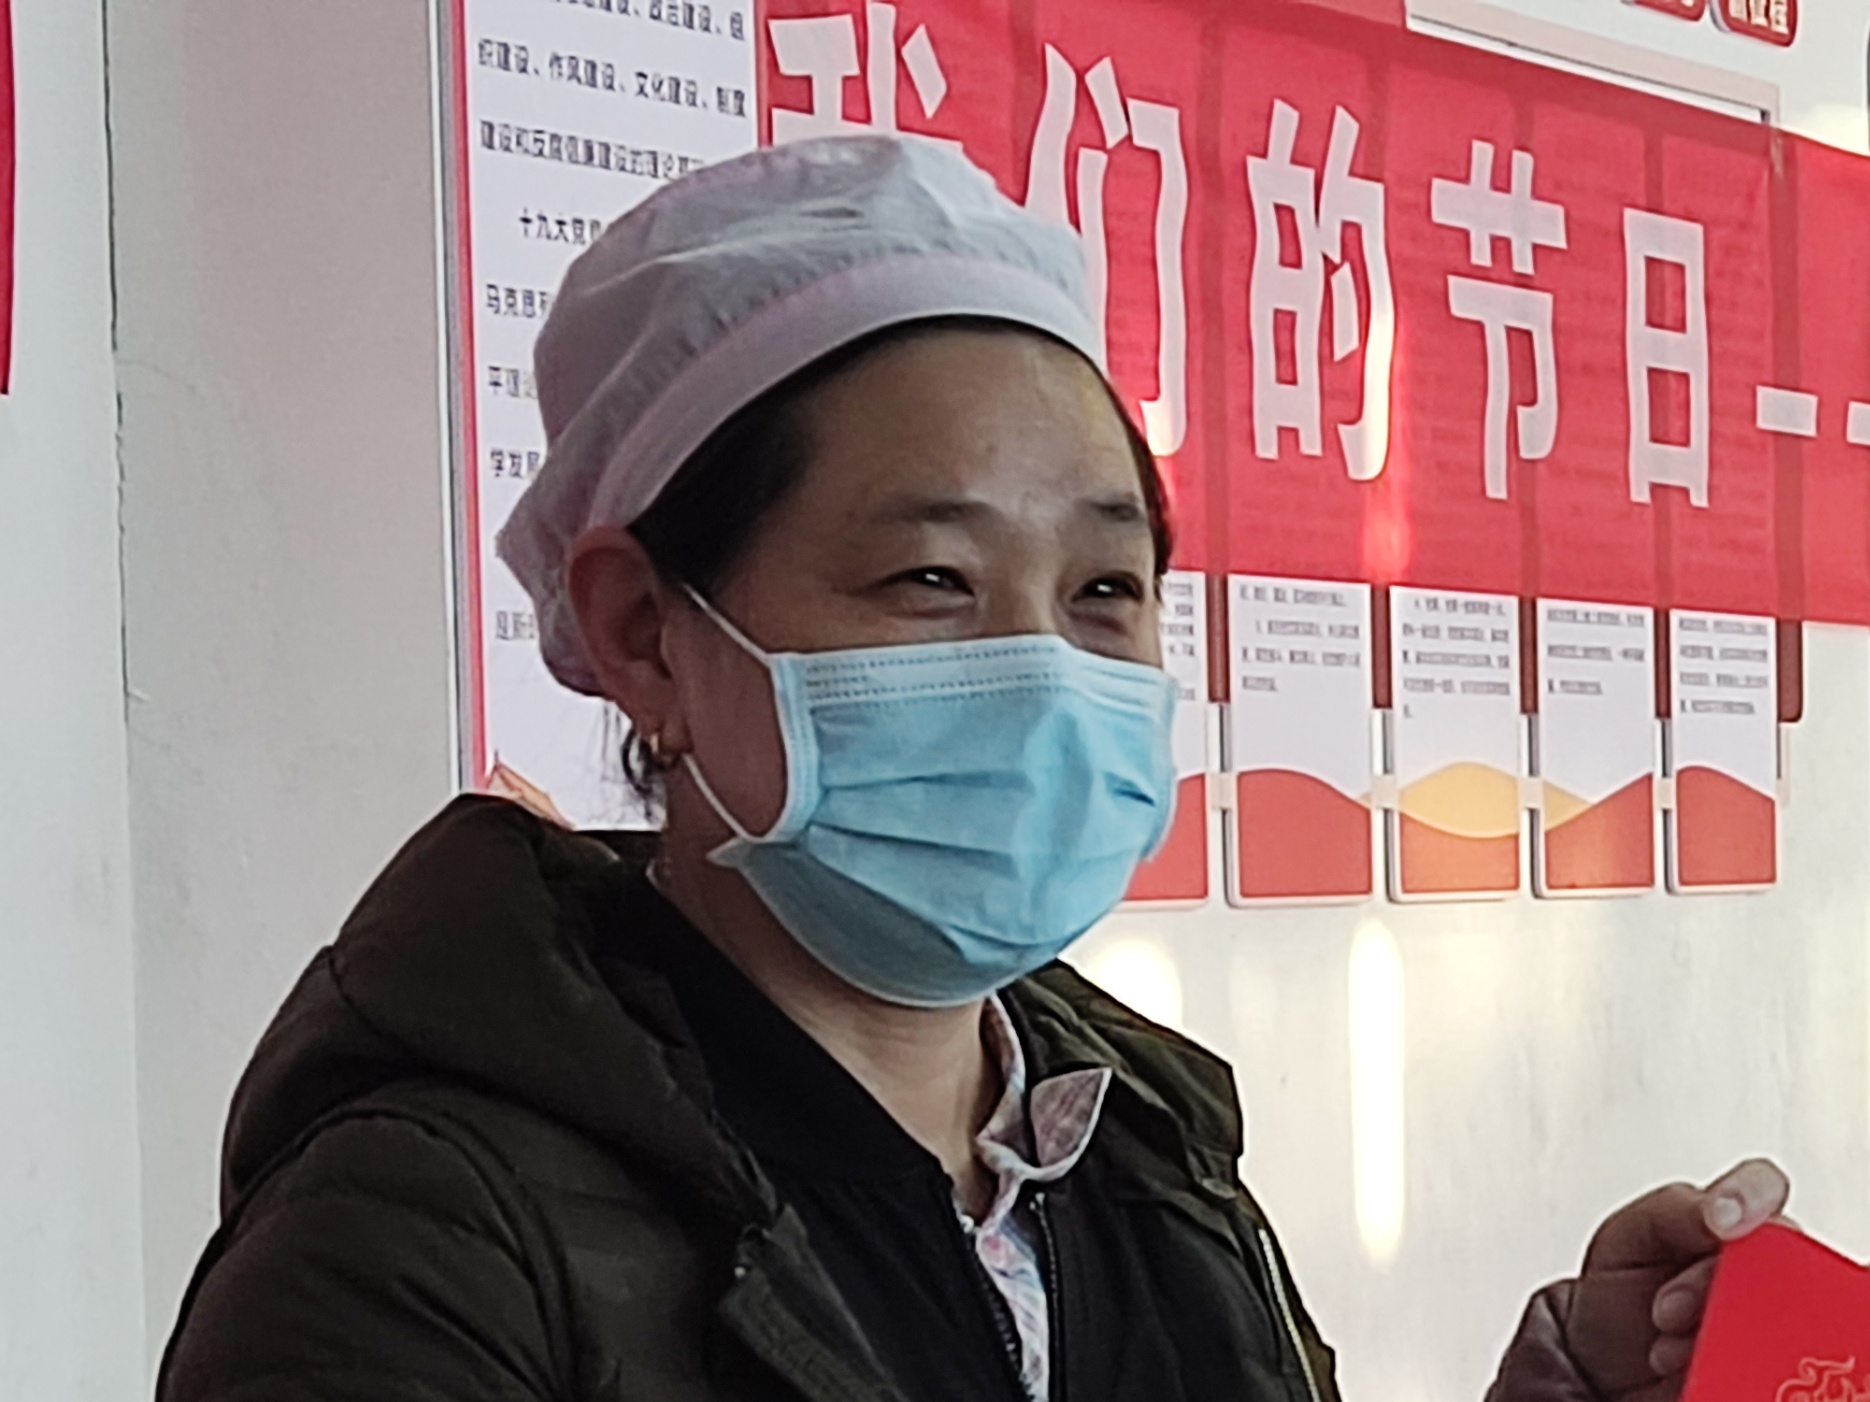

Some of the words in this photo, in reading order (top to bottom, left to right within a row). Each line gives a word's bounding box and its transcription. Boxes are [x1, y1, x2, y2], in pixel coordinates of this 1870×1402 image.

[480, 120, 704, 180] 建设和反腐倡廉建设的理论基
